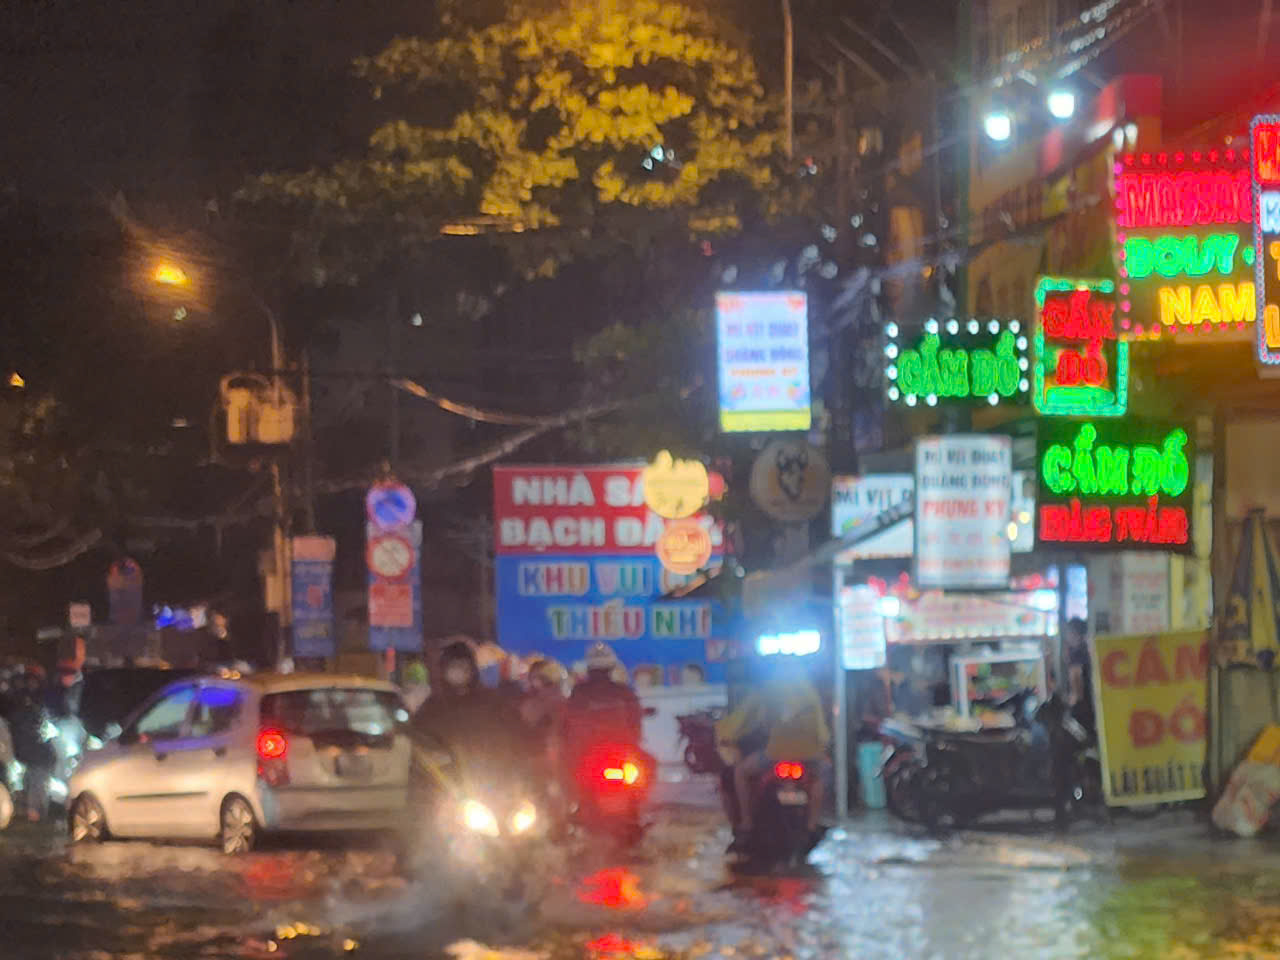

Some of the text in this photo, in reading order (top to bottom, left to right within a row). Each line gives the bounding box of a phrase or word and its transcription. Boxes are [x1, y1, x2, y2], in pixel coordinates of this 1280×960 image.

[1124, 232, 1239, 278] BODY
[1159, 281, 1256, 325] NAM
[1043, 423, 1129, 495] CẦM
[512, 471, 595, 507] NHÀ
[500, 516, 606, 552] BẠCH
[517, 562, 590, 597] KHU
[595, 561, 653, 596] VUI
[547, 598, 712, 641] THIẾU NHI
